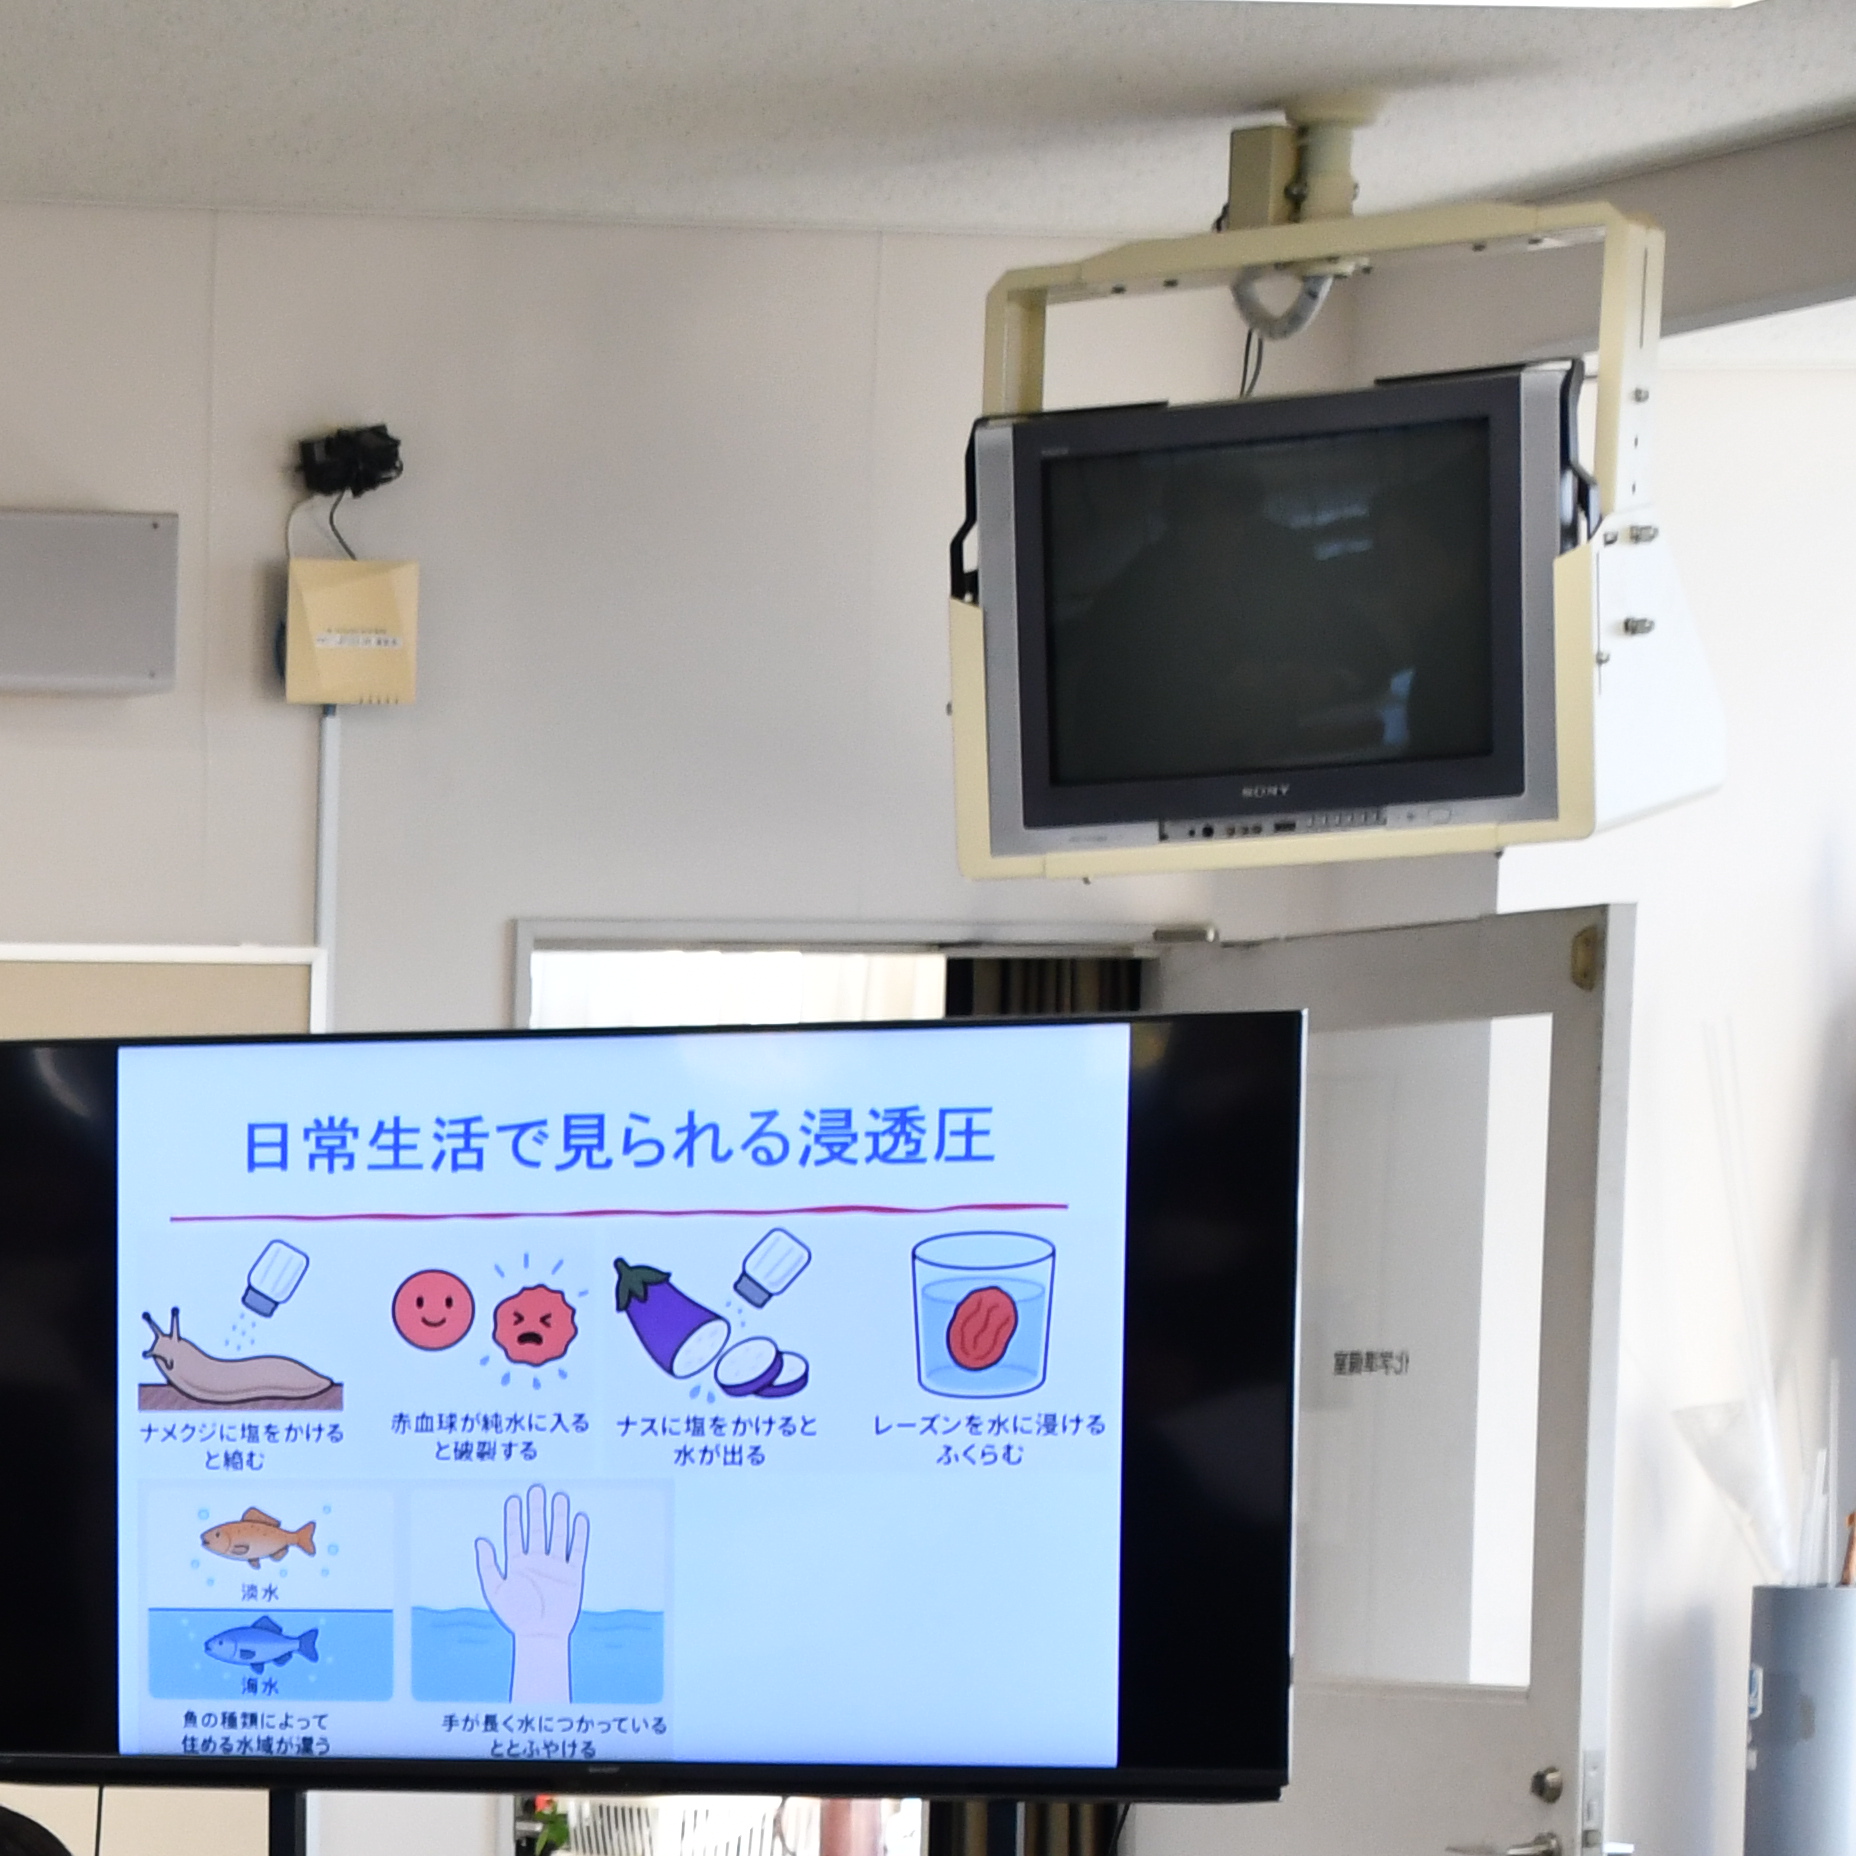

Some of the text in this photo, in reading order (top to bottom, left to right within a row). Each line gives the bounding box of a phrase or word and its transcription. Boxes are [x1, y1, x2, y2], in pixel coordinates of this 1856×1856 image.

[246, 1104, 996, 1175] 日常生活で見られる浸透圧
[139, 1422, 344, 1444] ナメクジに塩をかける
[390, 1411, 590, 1435] 赤血球が純水に入る
[616, 1414, 818, 1438] ナスに塩をかけると
[874, 1412, 1106, 1437] レーズンを水に浸ける
[434, 1439, 538, 1463] と破裂する
[673, 1444, 766, 1467] 水が出る
[936, 1443, 1025, 1466] ふくらむ
[241, 1583, 280, 1602] 淡水
[241, 1676, 280, 1697] 海水
[182, 1709, 329, 1731] 魚の種類によって
[441, 1713, 668, 1736] 手が長く水につかっている
[181, 1733, 331, 1756] 住める水域が違う
[490, 1738, 597, 1760] ととふやける
